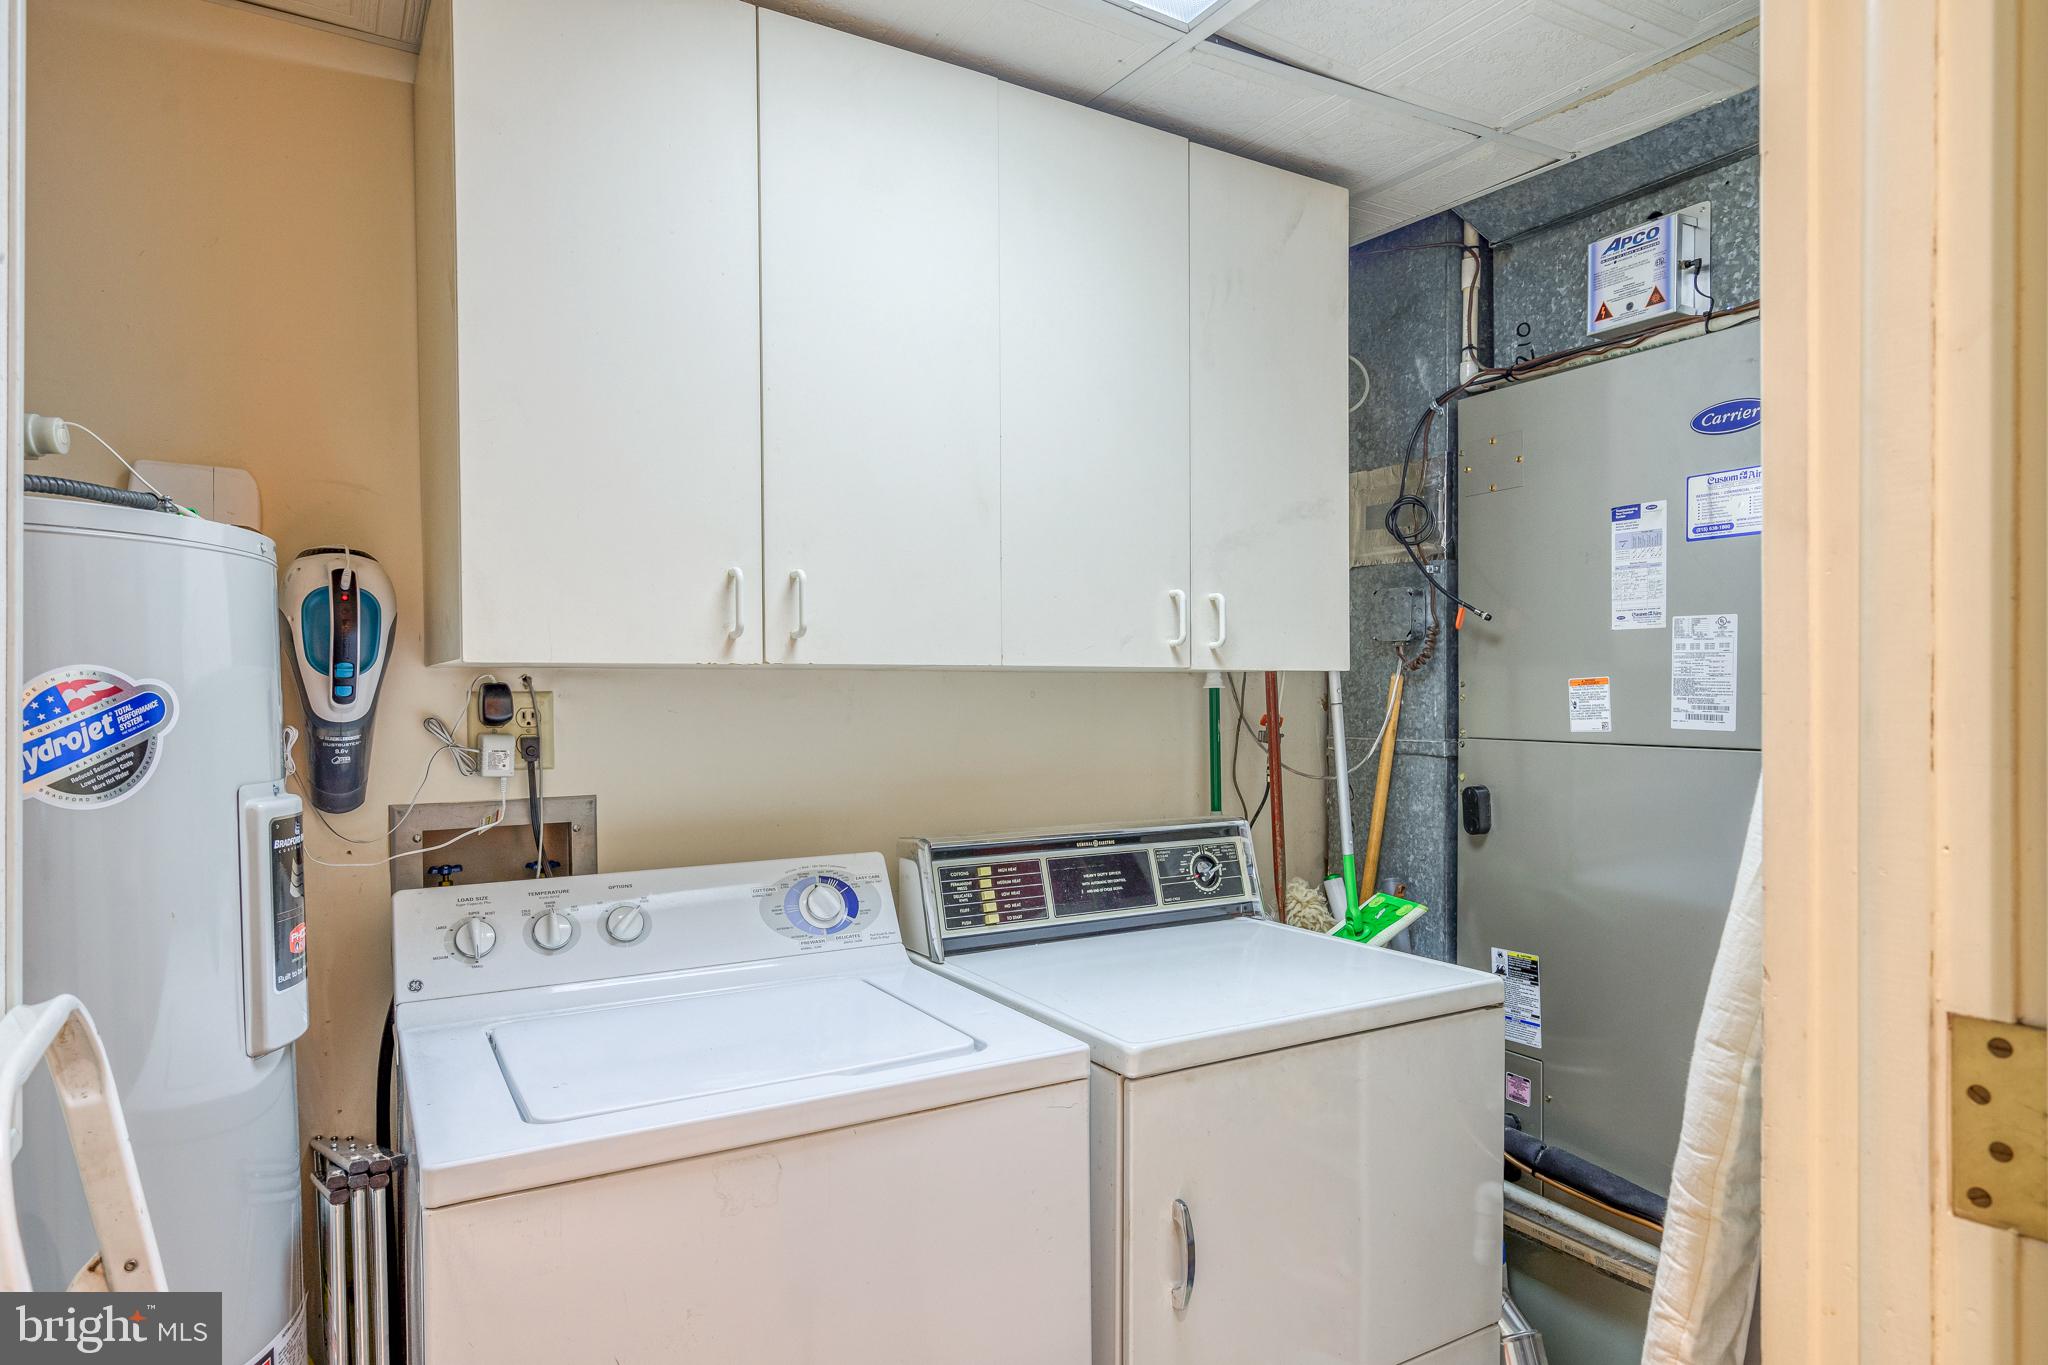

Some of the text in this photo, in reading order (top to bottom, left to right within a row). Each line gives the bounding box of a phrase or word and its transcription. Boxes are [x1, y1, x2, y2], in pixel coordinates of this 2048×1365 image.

[1602, 227, 1660, 256] APCO
[1701, 406, 1761, 427] Carrier
[114, 703, 134, 716] TOTAL
[117, 699, 159, 724] PERFORMANCE
[119, 715, 143, 731] SYSTEM
[69, 743, 126, 771] FEATURING
[80, 778, 97, 789] Lower
[92, 781, 106, 792] More
[528, 889, 570, 897] TEMPERATURE
[836, 933, 860, 941] DELICATES
